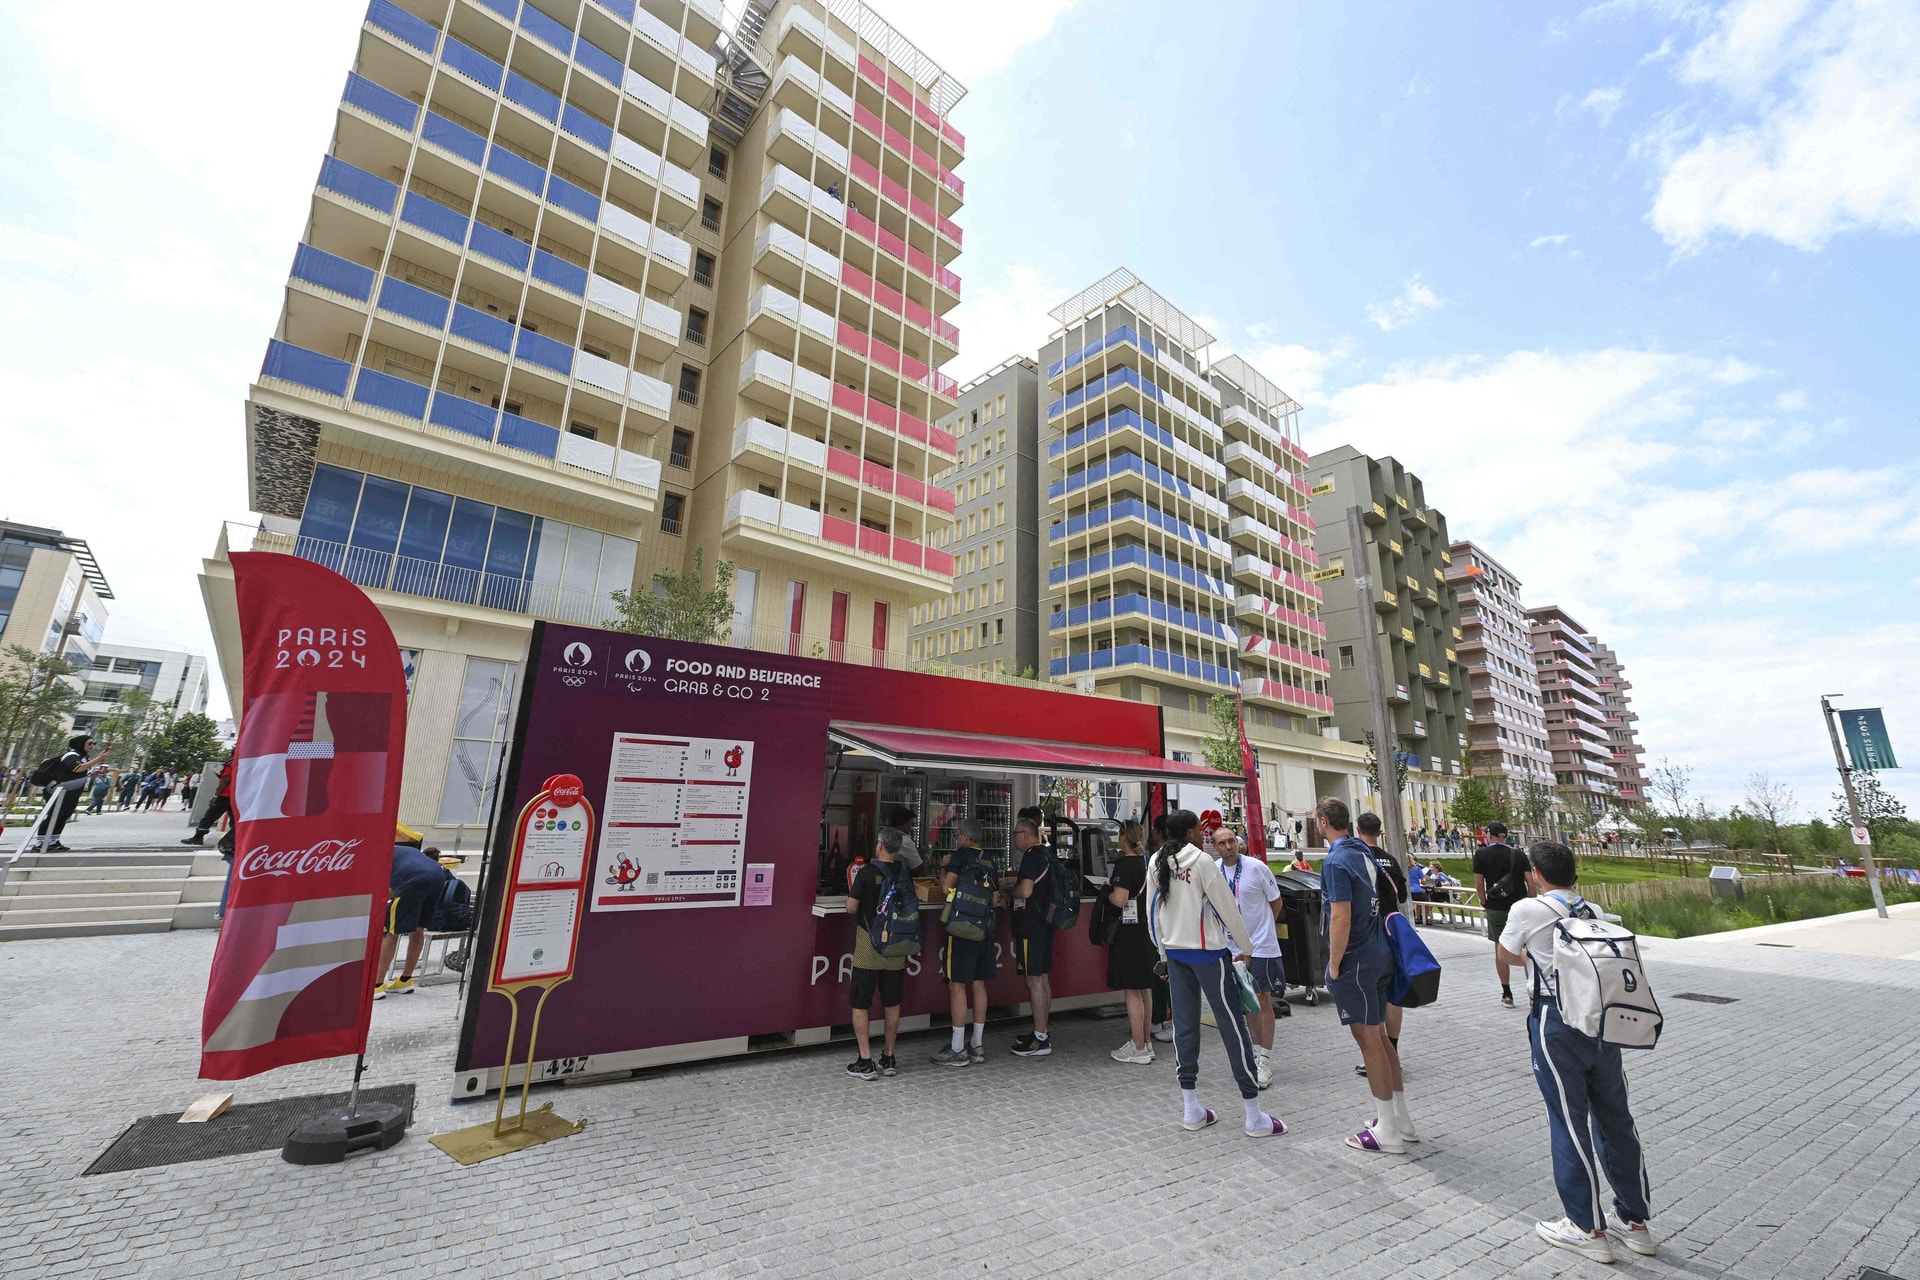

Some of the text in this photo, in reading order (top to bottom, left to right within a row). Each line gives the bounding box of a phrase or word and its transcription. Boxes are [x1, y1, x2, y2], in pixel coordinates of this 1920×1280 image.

[275, 649, 366, 669] 2024
[552, 666, 598, 677] PARIS 2024
[614, 672, 657, 683] PARIS 2024
[665, 657, 822, 688] FOOD AND BEVERAGE
[664, 678, 770, 702] GRAB & GO 2
[1857, 715, 1871, 737] 2024
[1863, 738, 1877, 762] PARIS
[238, 838, 365, 880] Coca-Cola
[810, 952, 922, 986] PAS
[545, 1056, 589, 1076] 427
